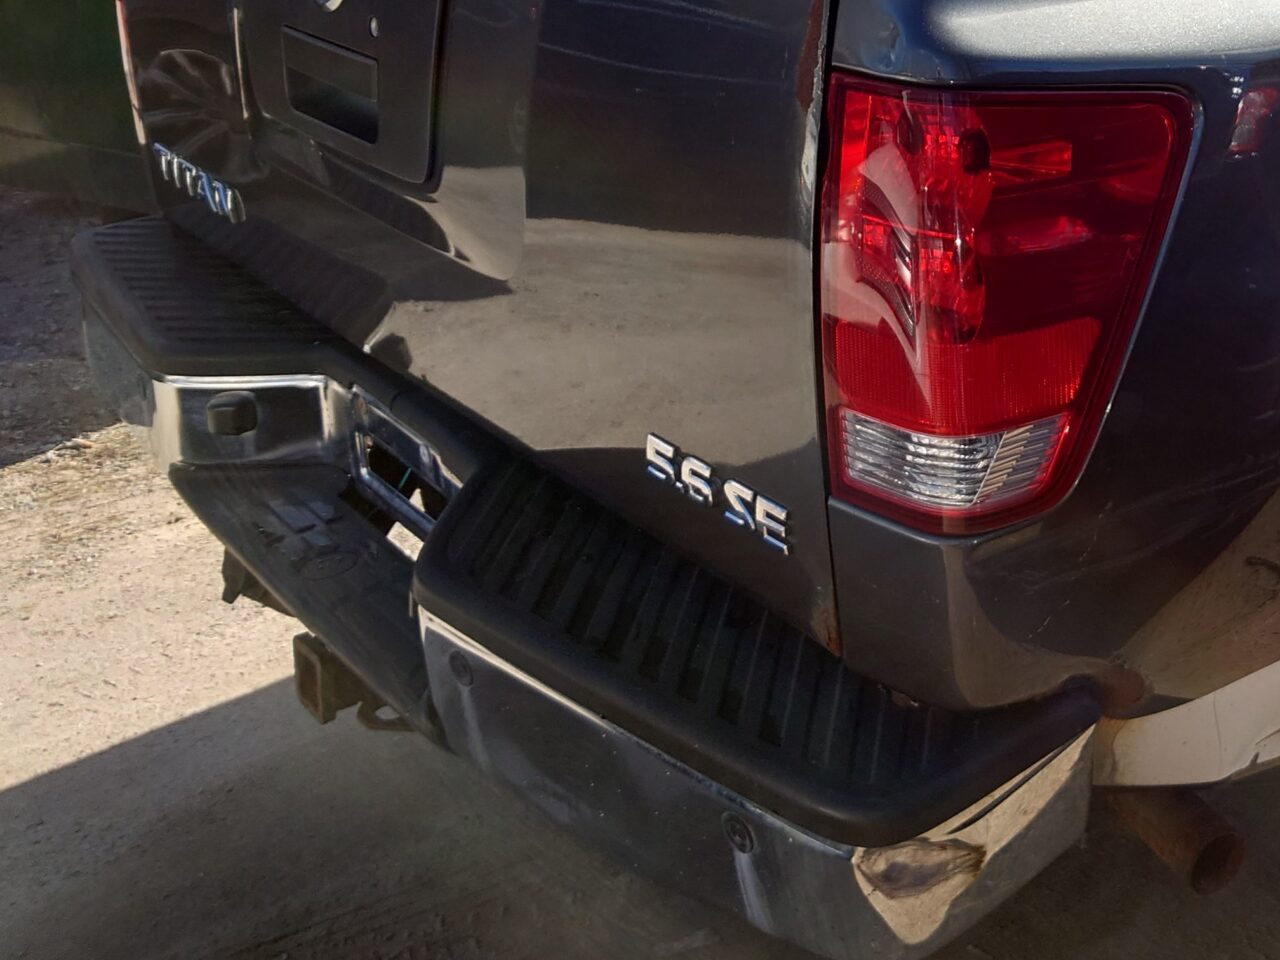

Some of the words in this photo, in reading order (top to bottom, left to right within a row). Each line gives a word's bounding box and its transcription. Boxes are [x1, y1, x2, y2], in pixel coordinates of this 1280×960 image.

[152, 141, 247, 224] TITAN
[645, 432, 714, 507] 5.6
[723, 478, 790, 557] SE
